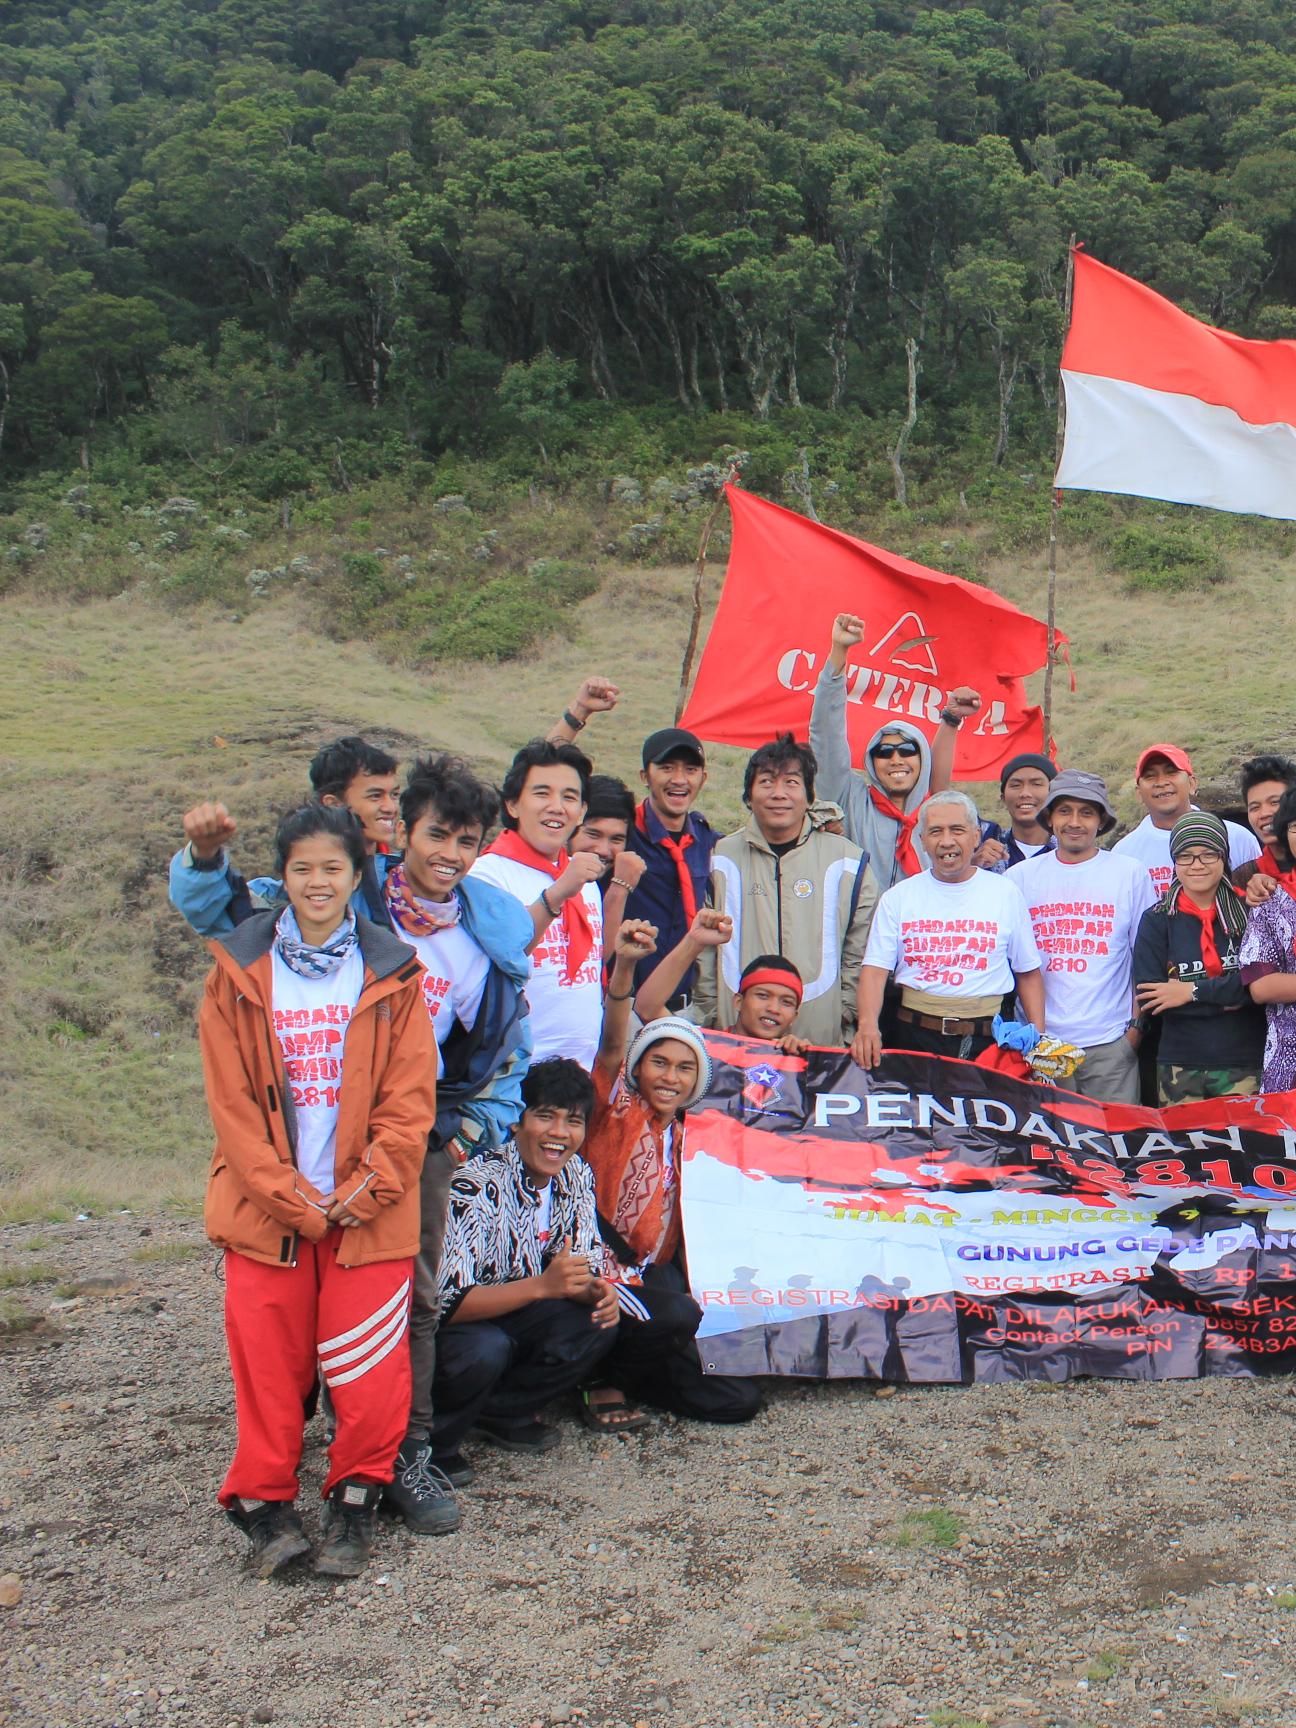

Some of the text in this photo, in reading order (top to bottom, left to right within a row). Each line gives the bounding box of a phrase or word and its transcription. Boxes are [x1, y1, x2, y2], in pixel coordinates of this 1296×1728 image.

[777, 648, 1010, 736] CTERA
[1029, 902, 1115, 921] PENDAKIAN
[901, 919, 998, 936] PENDAKIAN
[812, 1091, 1246, 1160] PENDAKIAN
[956, 1239, 1106, 1262] GUNUNG
[1115, 1235, 1205, 1255] GEDE
[962, 1265, 1150, 1292] REGITRASI
[1214, 1266, 1257, 1287] Rp
[701, 1288, 899, 1312] REGISTRASI
[908, 1295, 995, 1322] DAPAT
[1005, 1299, 1186, 1326] DILAKUKAN
[984, 1327, 1082, 1344] Contact
[1089, 1318, 1181, 1342] Person
[1125, 1337, 1174, 1357] PIN
